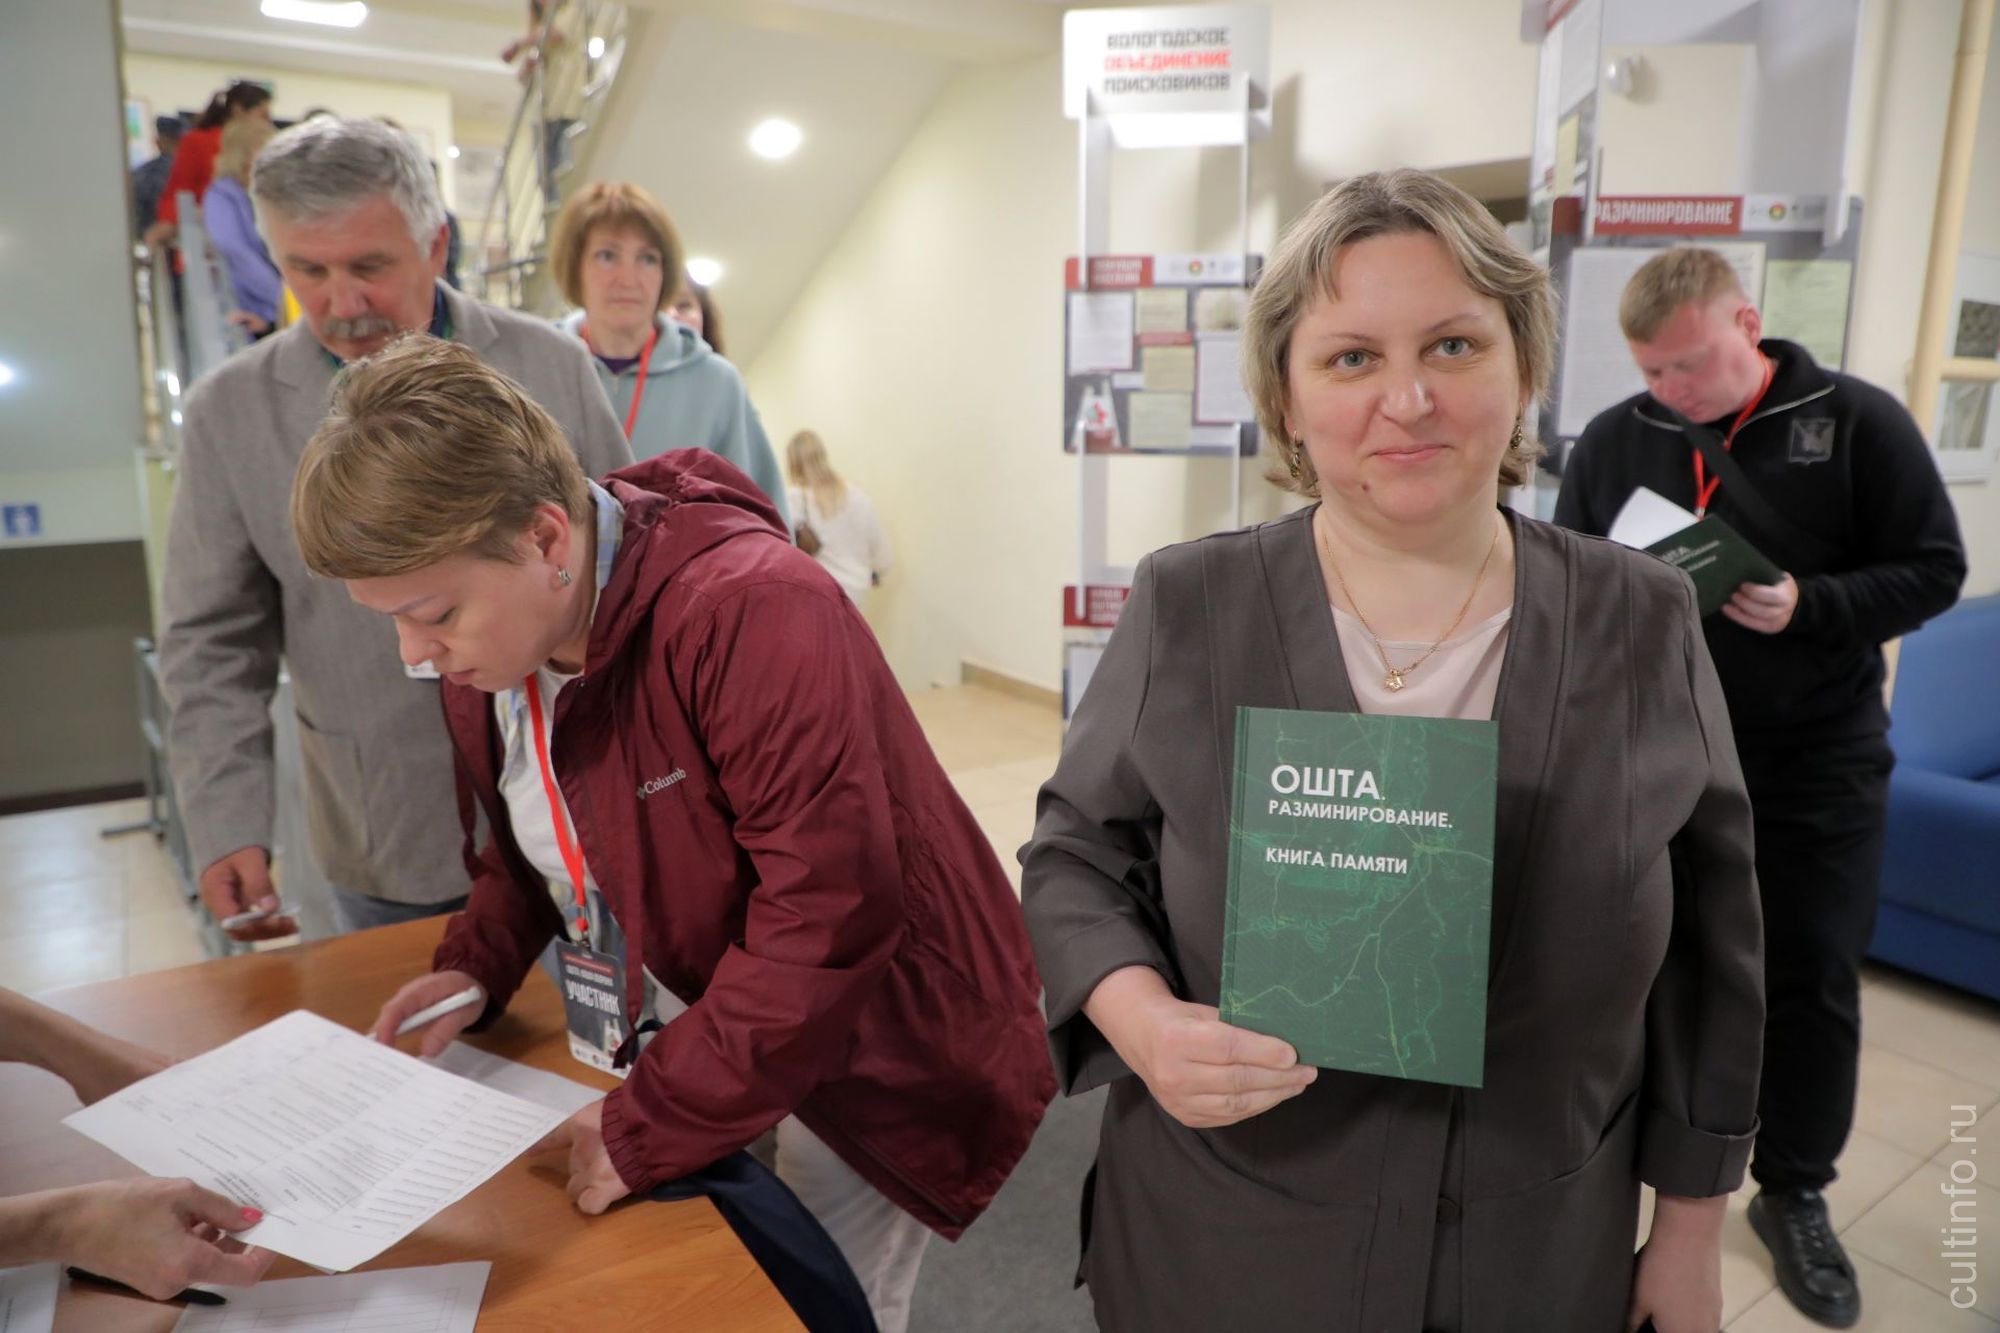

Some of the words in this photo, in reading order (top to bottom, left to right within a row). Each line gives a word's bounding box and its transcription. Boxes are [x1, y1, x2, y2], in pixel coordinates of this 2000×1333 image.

[644, 767, 687, 794] Columb
[1271, 764, 1386, 801] ОШТА.
[1268, 800, 1453, 828] РАЗМИНИРОВАНИЕ.
[1266, 848, 1325, 867] КНИГА
[1331, 853, 1408, 874] ПАМЯТИ
[565, 978, 621, 1016] УЧАСТНИК
